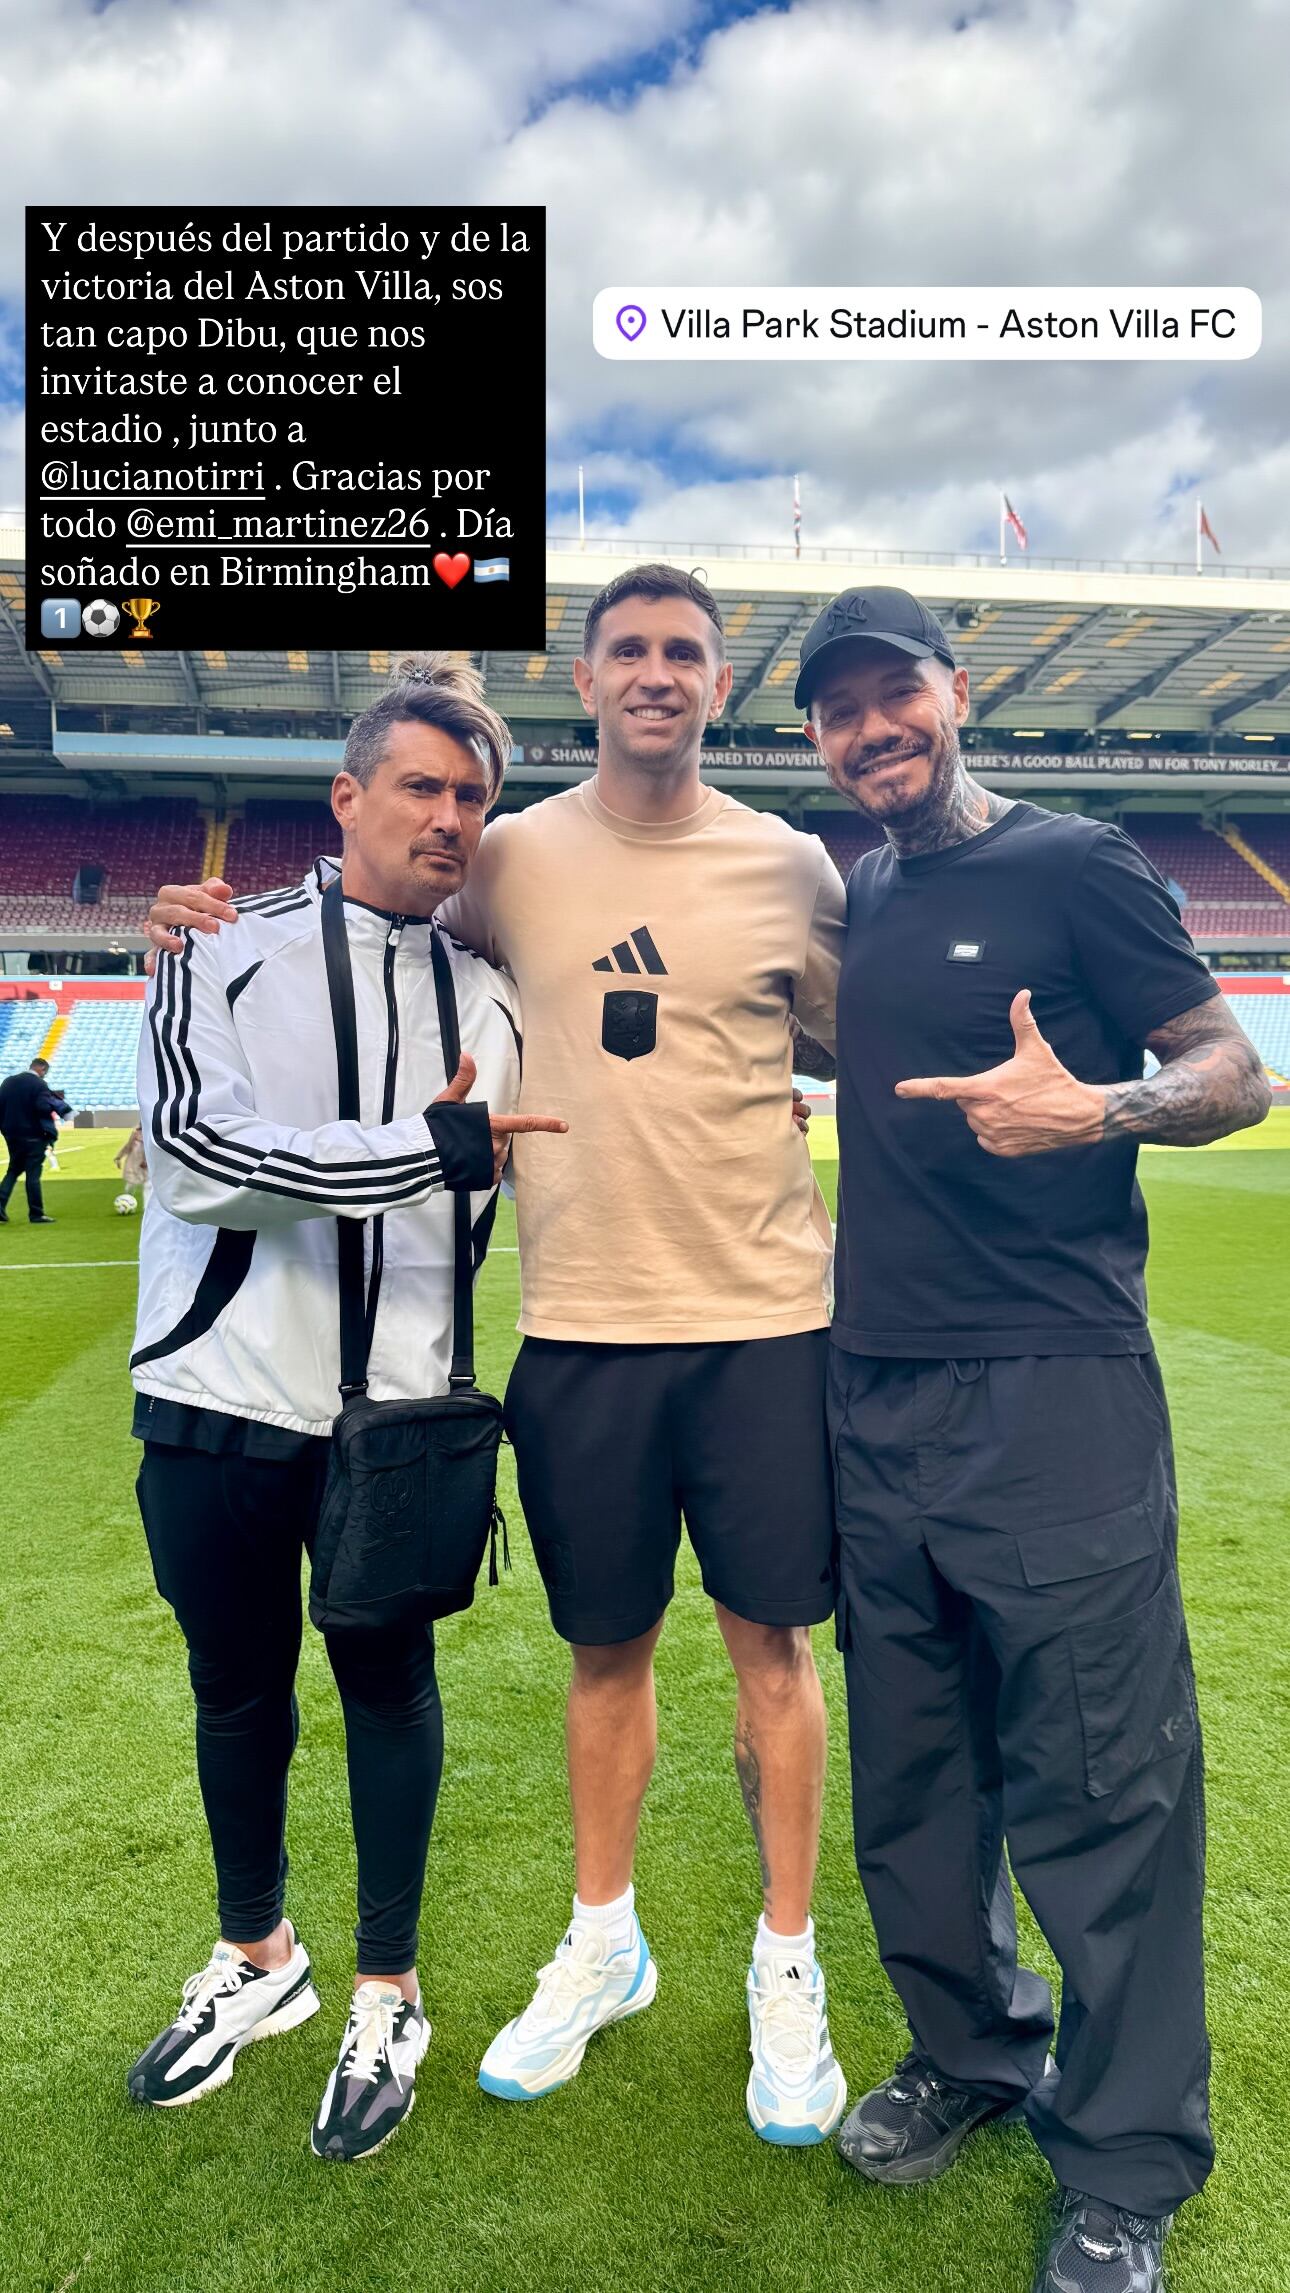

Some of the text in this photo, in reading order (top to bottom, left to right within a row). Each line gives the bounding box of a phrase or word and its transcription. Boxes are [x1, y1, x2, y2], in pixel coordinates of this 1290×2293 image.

[744, 752, 763, 765] TO
[1011, 755, 1022, 768] A
[1023, 755, 1062, 768] GOOD
[1065, 756, 1096, 769] BALL
[1097, 756, 1144, 769] PLAYED
[1148, 757, 1164, 769] IN
[1164, 758, 1190, 770] FOR
[1192, 758, 1229, 770] TONY
